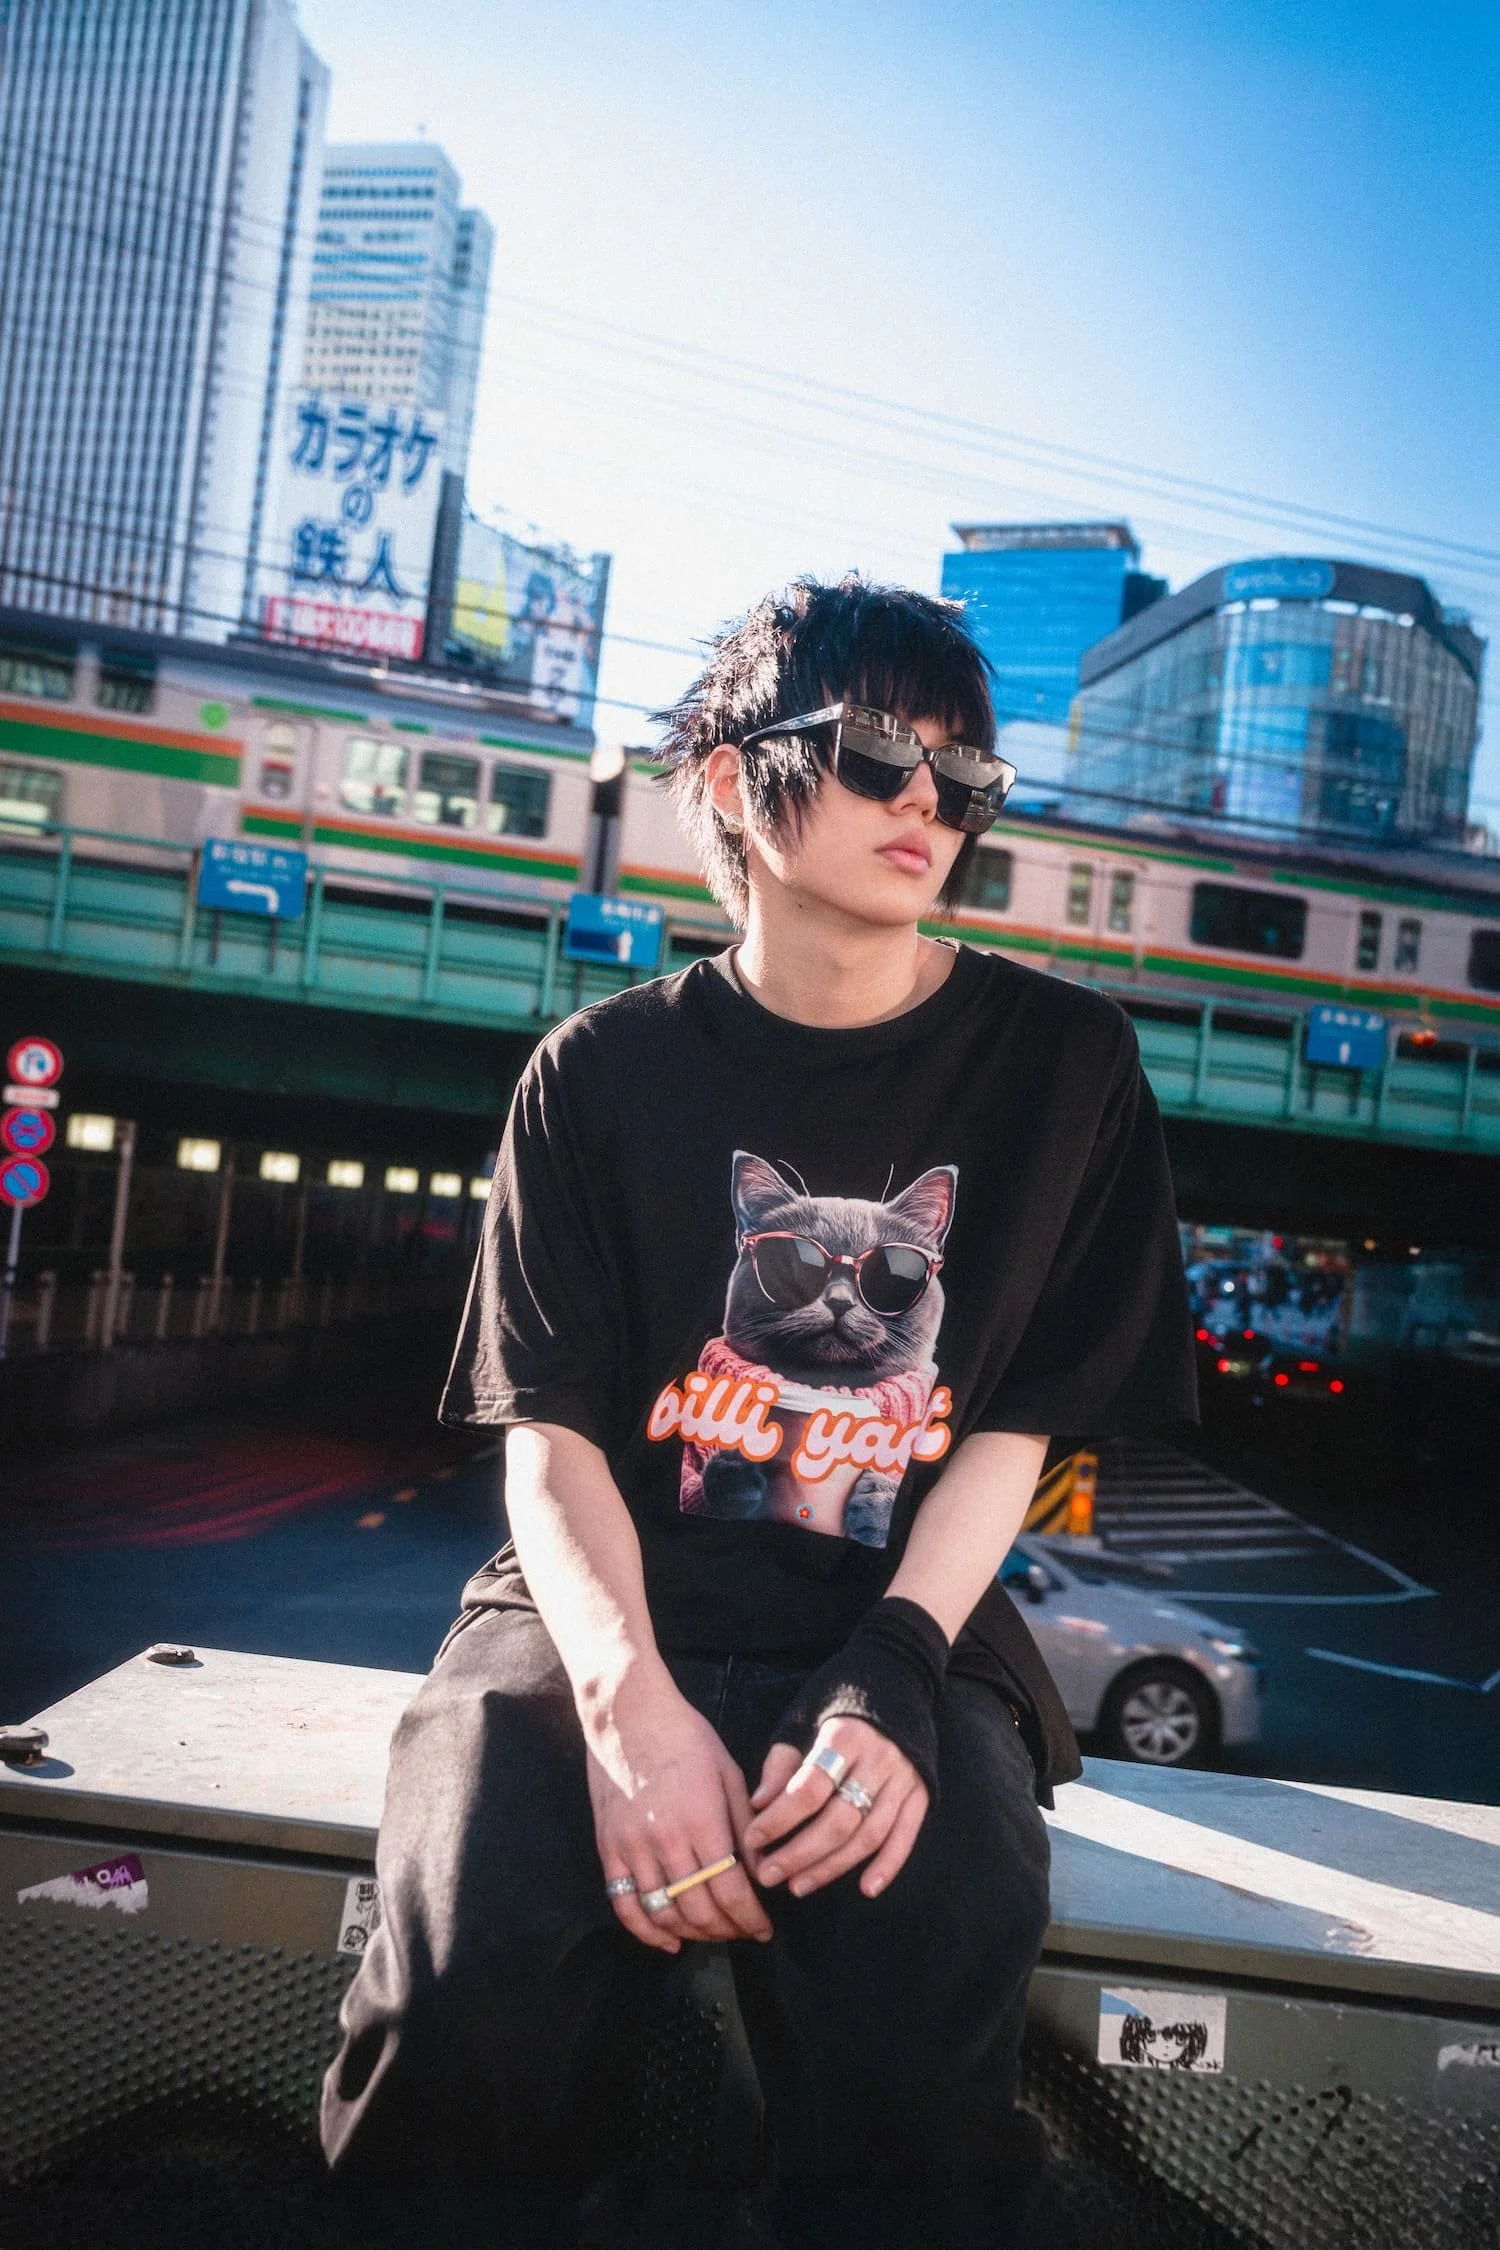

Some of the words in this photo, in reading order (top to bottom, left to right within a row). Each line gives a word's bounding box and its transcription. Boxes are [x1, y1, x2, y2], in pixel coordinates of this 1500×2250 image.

[292, 398, 438, 490] カラオケ
[341, 483, 374, 525] の
[293, 522, 408, 599] 鉄人
